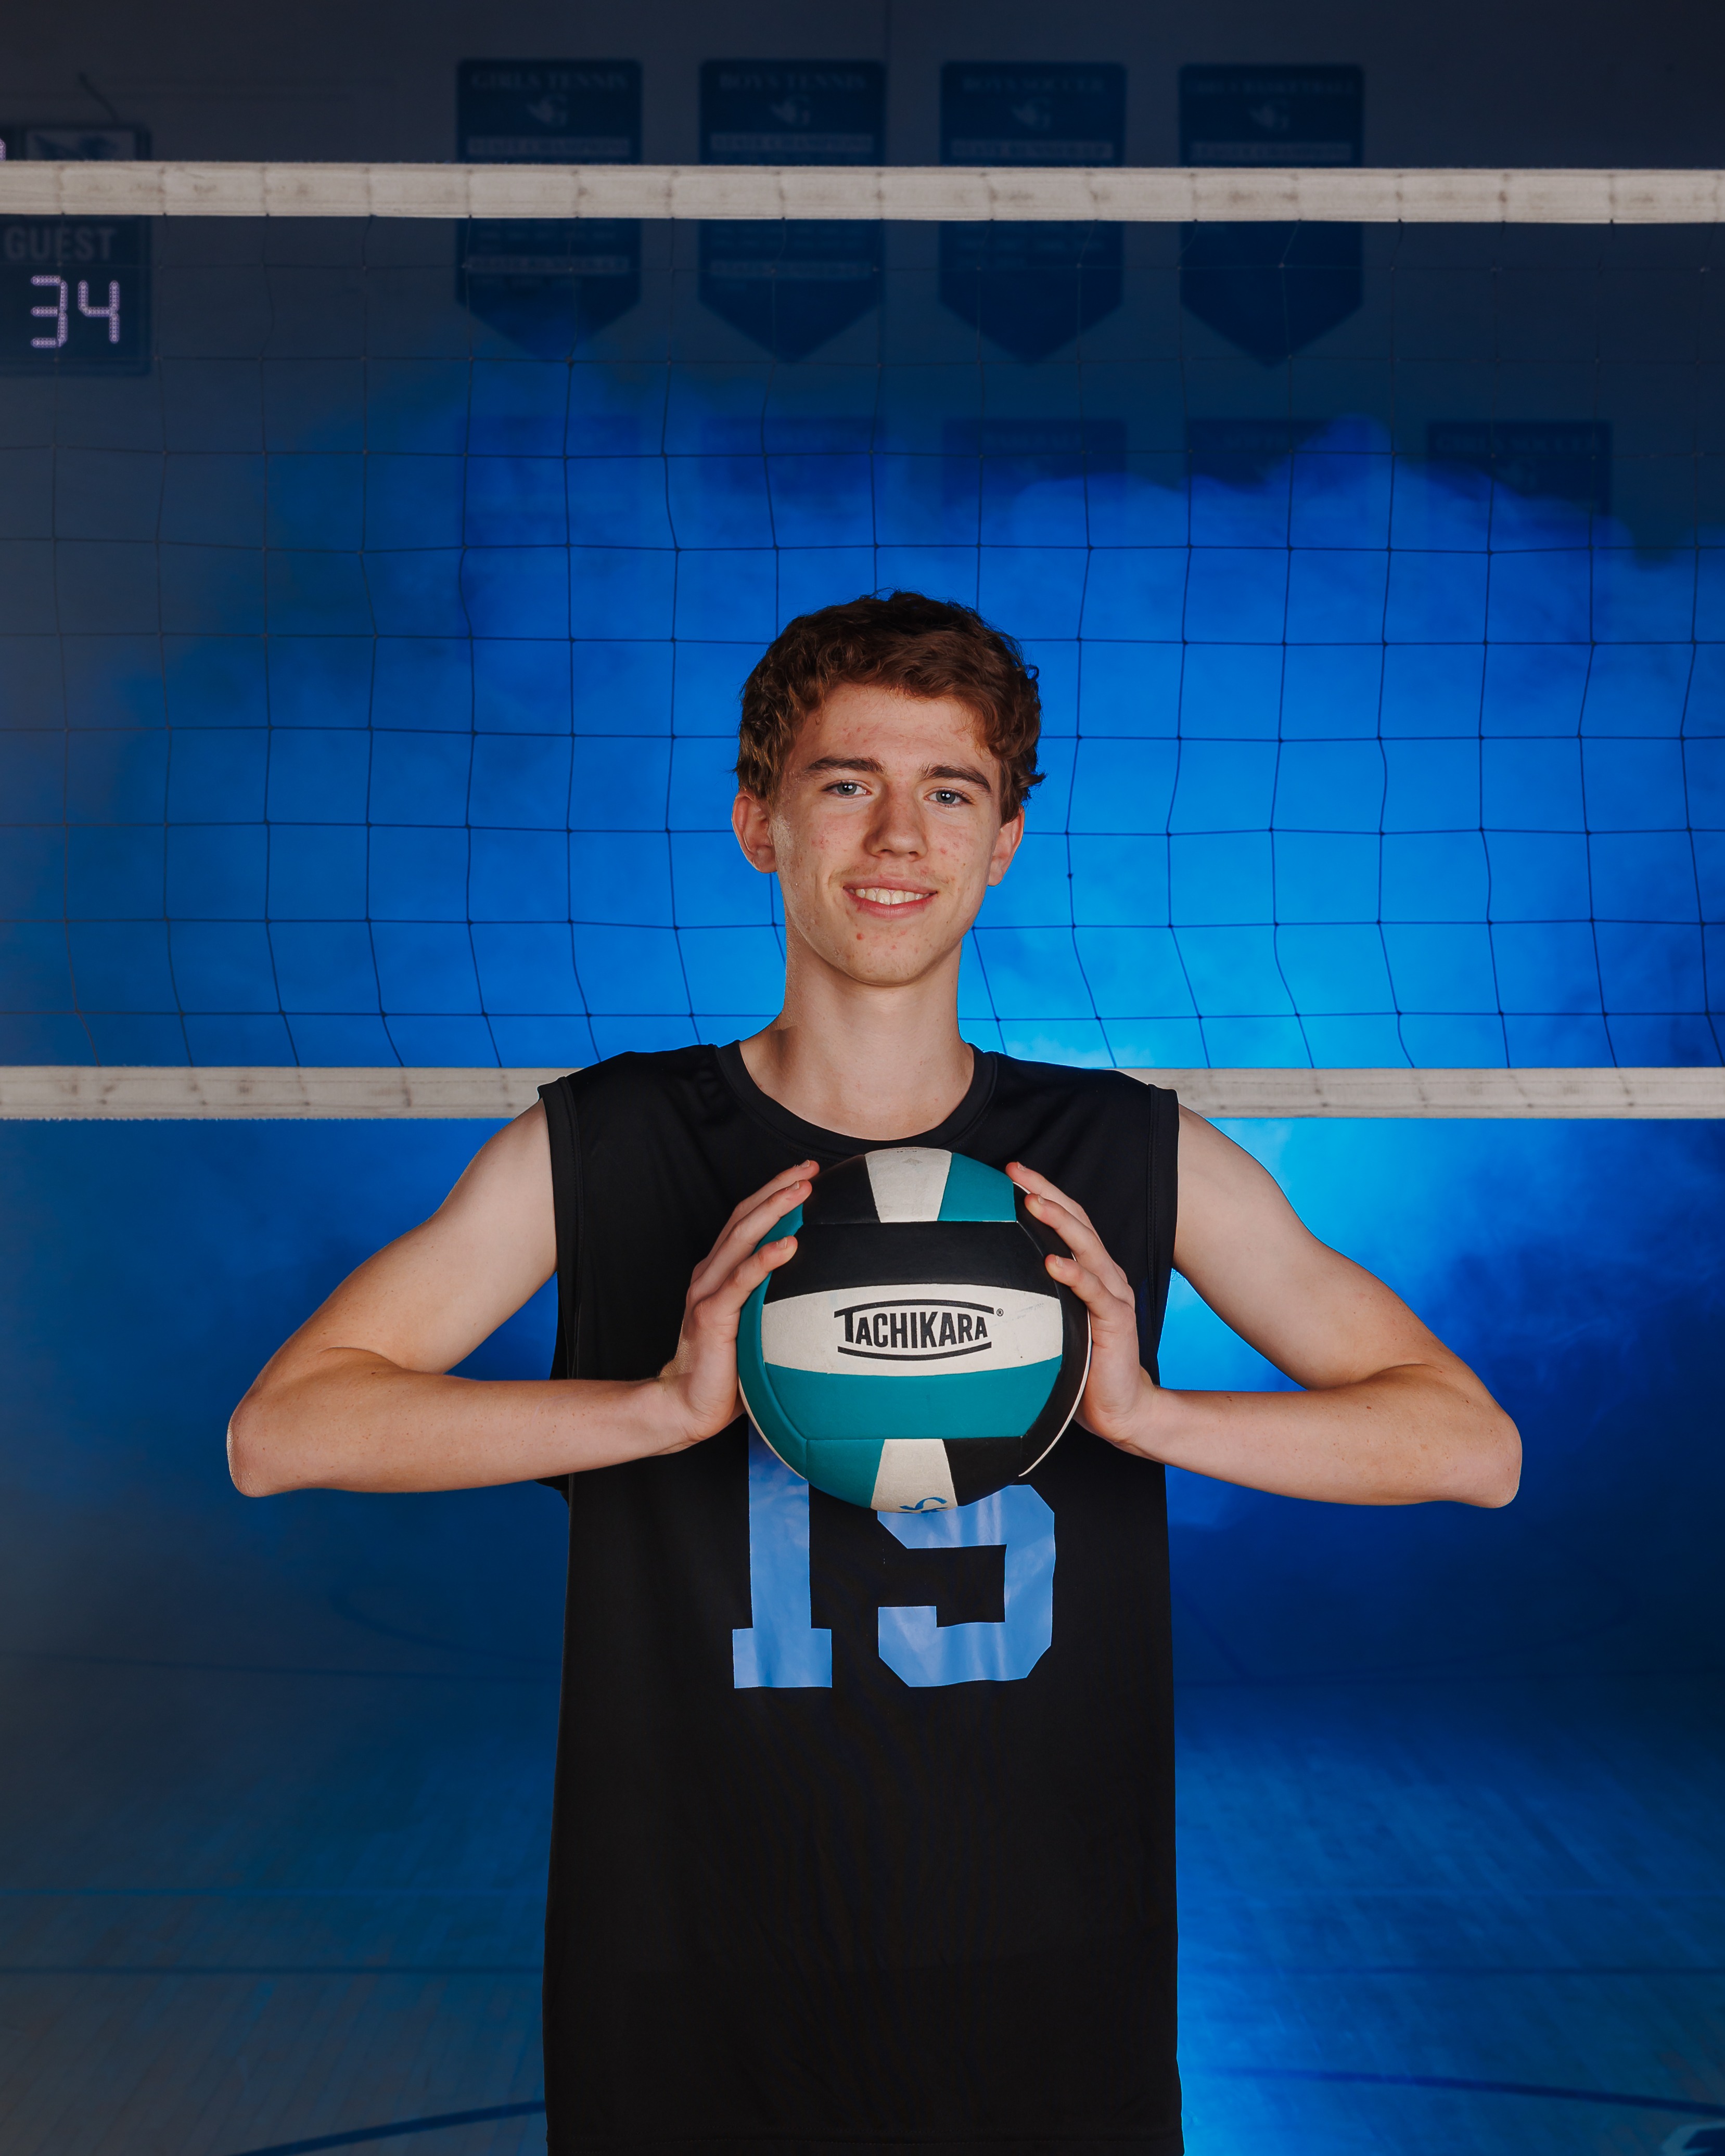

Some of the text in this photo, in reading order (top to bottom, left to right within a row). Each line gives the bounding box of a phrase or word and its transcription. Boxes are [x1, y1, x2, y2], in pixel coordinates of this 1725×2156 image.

[4, 226, 118, 261] GUEST
[30, 274, 120, 349] 34
[834, 1299, 994, 1349] TACHIKARA
